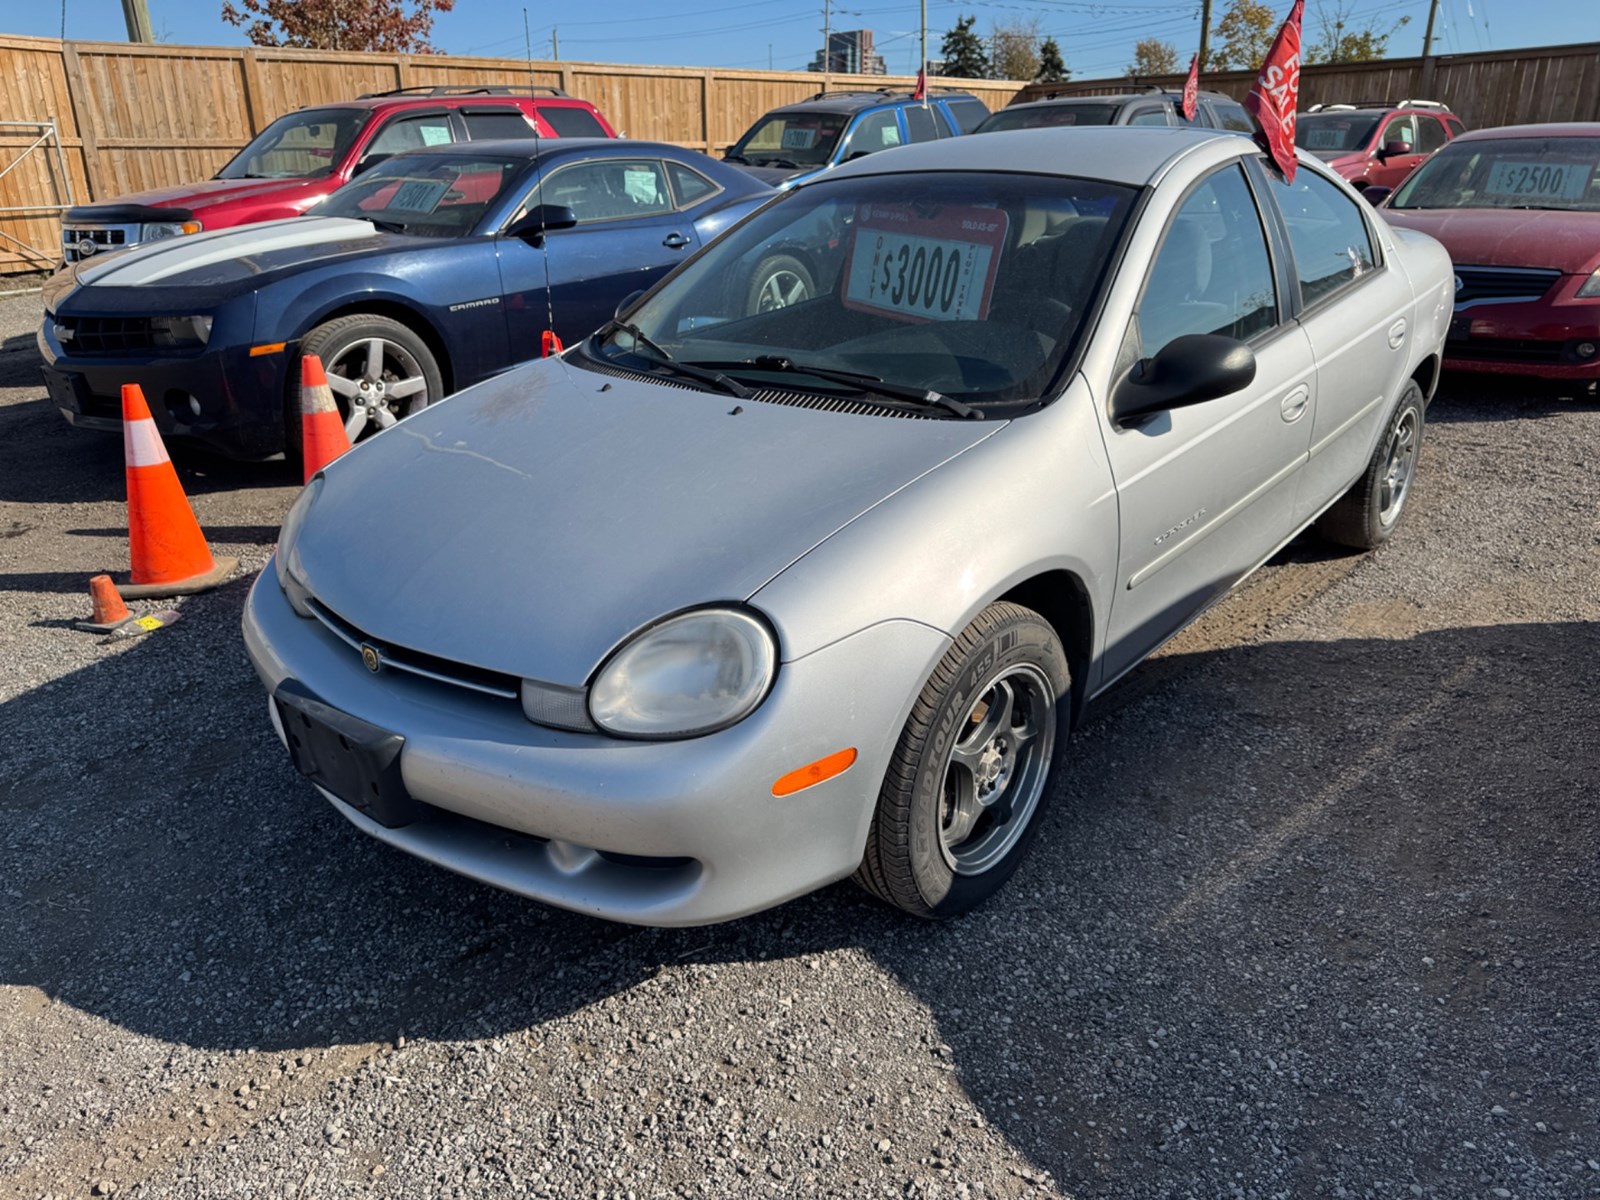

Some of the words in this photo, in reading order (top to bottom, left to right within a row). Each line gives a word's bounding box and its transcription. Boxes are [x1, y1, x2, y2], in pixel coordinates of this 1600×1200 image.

[1284, 52, 1300, 102] FO
[1506, 166, 1564, 195] $2500
[870, 236, 884, 300] ONLY
[880, 243, 961, 313] $3000
[449, 297, 500, 312] CAMARO
[917, 691, 964, 856] ROADTOUR
[970, 653, 993, 688] 455
